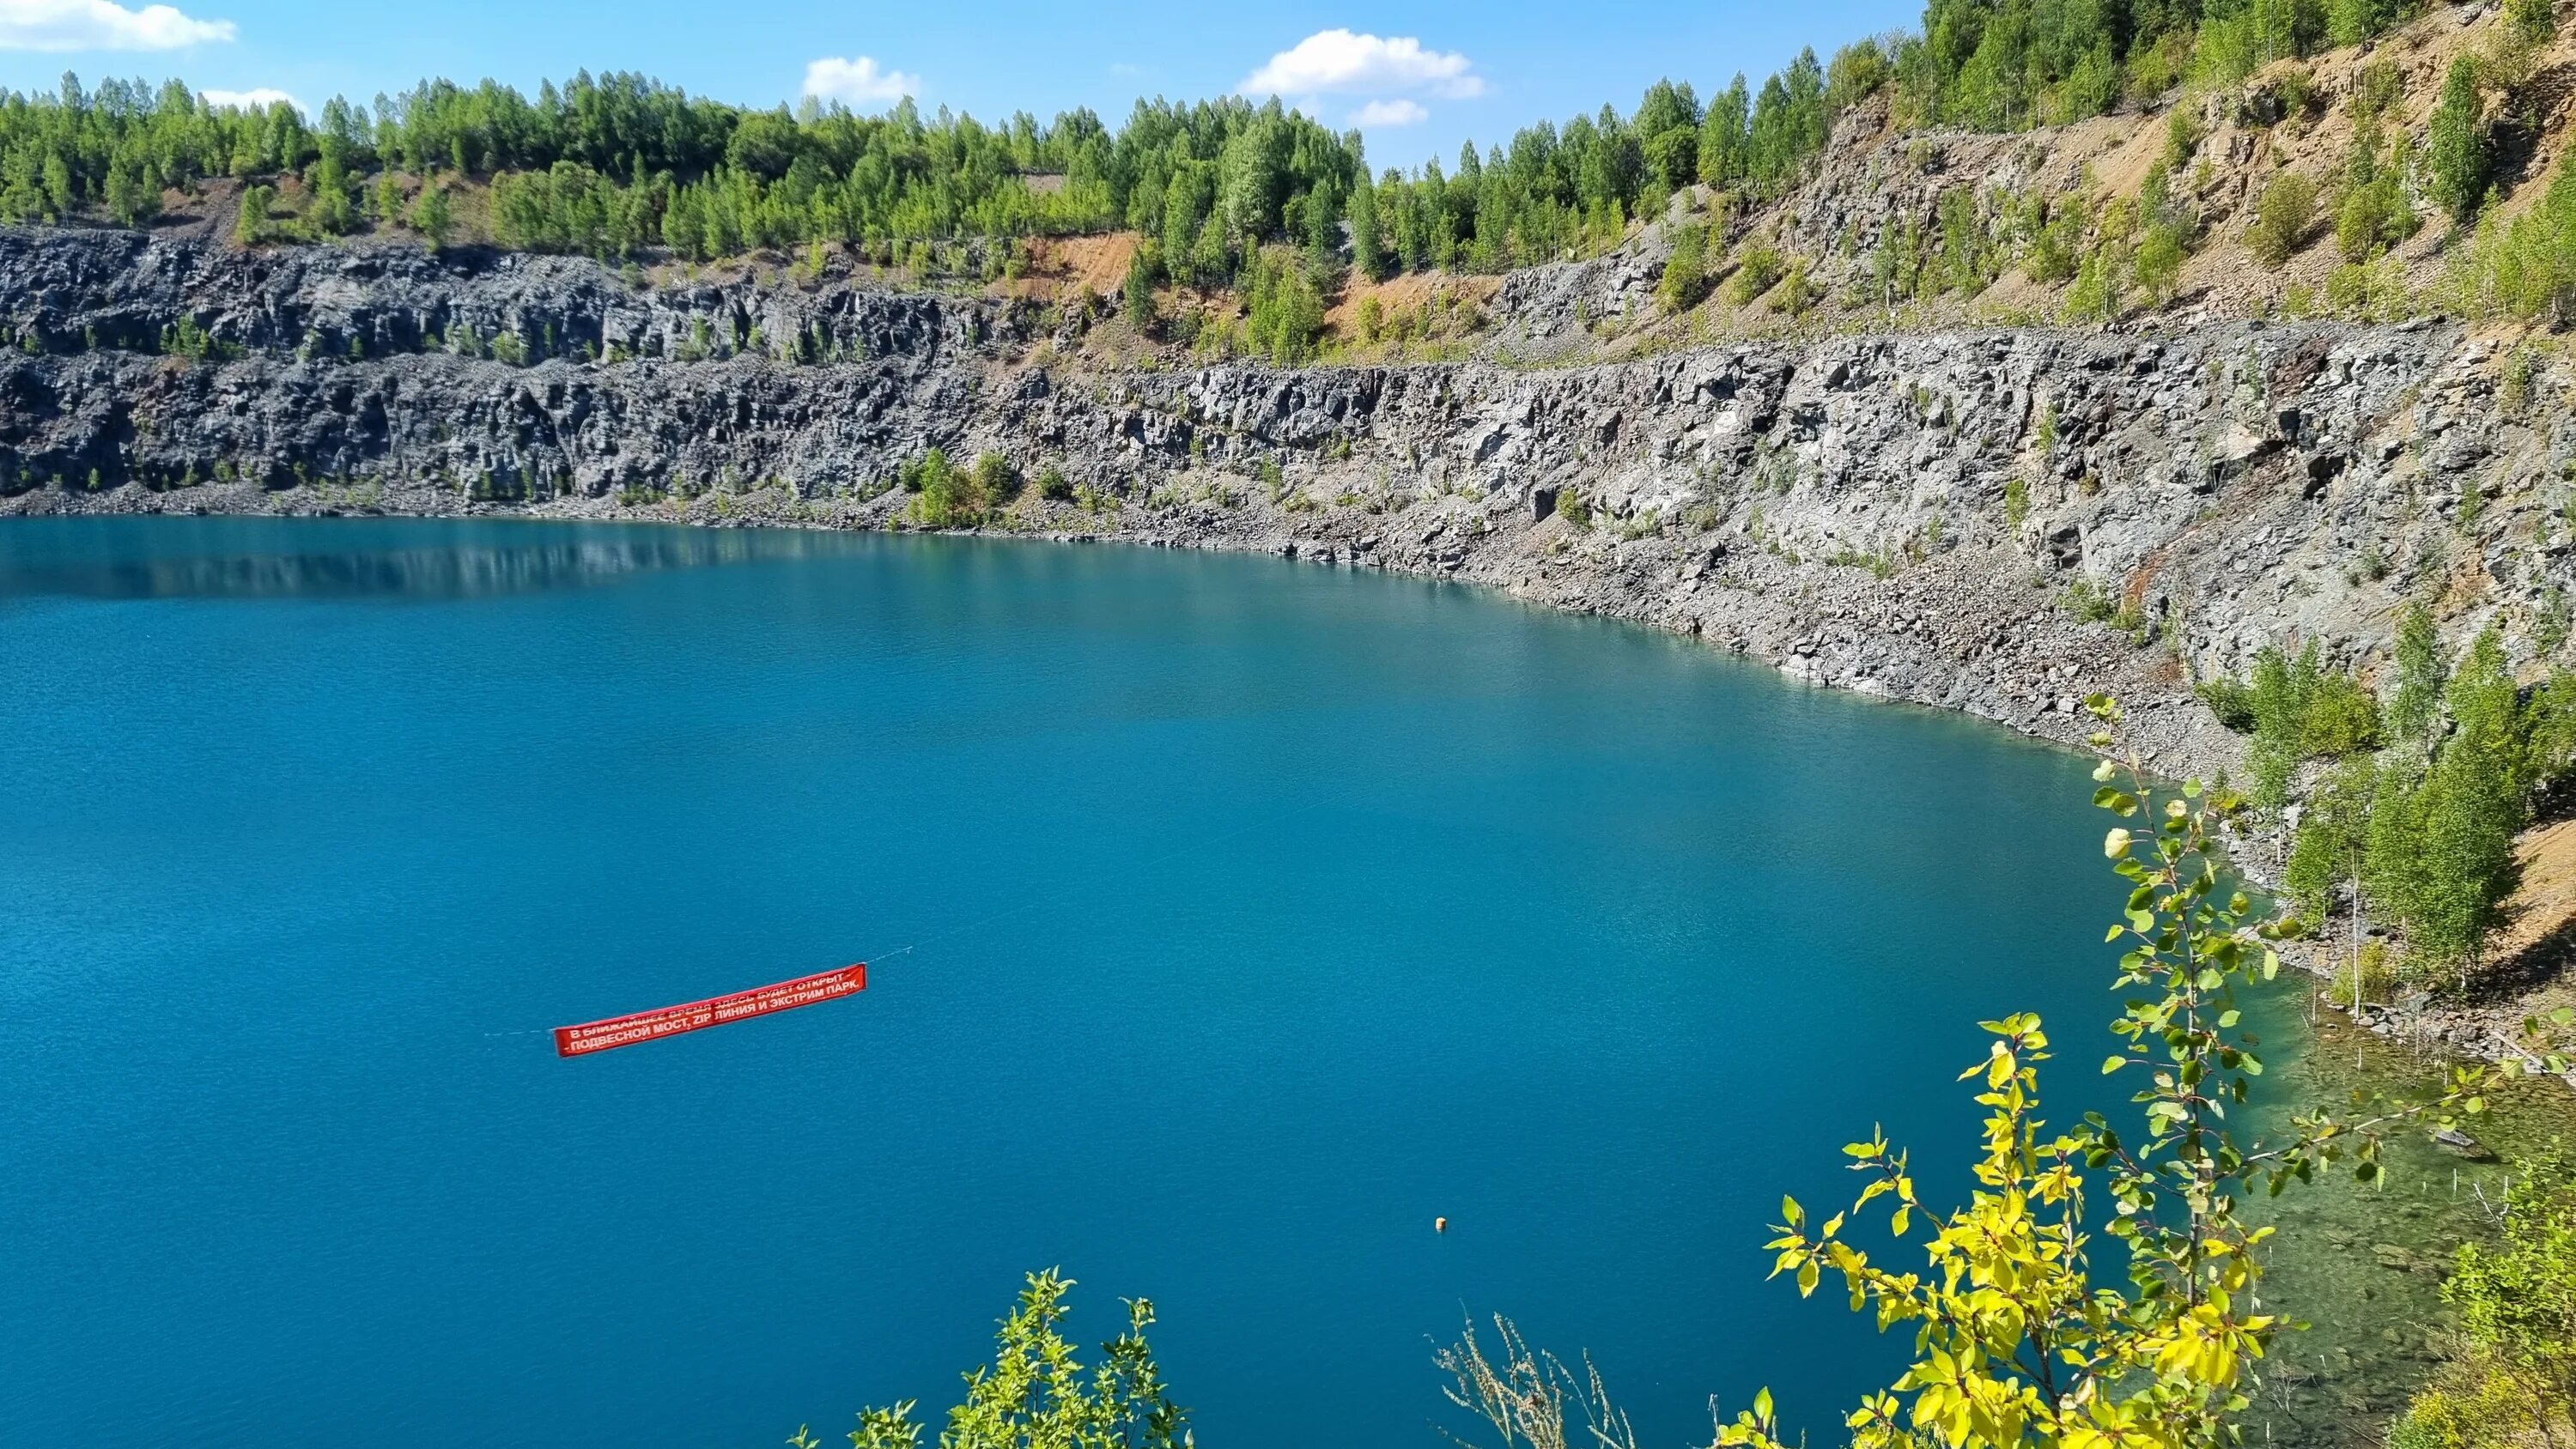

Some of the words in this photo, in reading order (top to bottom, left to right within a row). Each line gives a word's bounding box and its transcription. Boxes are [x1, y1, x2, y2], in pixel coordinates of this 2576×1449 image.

[570, 1029, 580, 1039] В
[796, 973, 844, 991] ОТКРЫТ
[571, 1025, 651, 1051] ПОДВЕСНОЙ
[653, 1018, 691, 1034] МОСТ,
[693, 1013, 712, 1025] ZIP
[714, 1004, 756, 1021] ЛИНИЯ
[758, 1001, 768, 1010] И
[770, 988, 824, 1008] ЭКСТРИМ
[826, 979, 860, 995] ПАРК.
